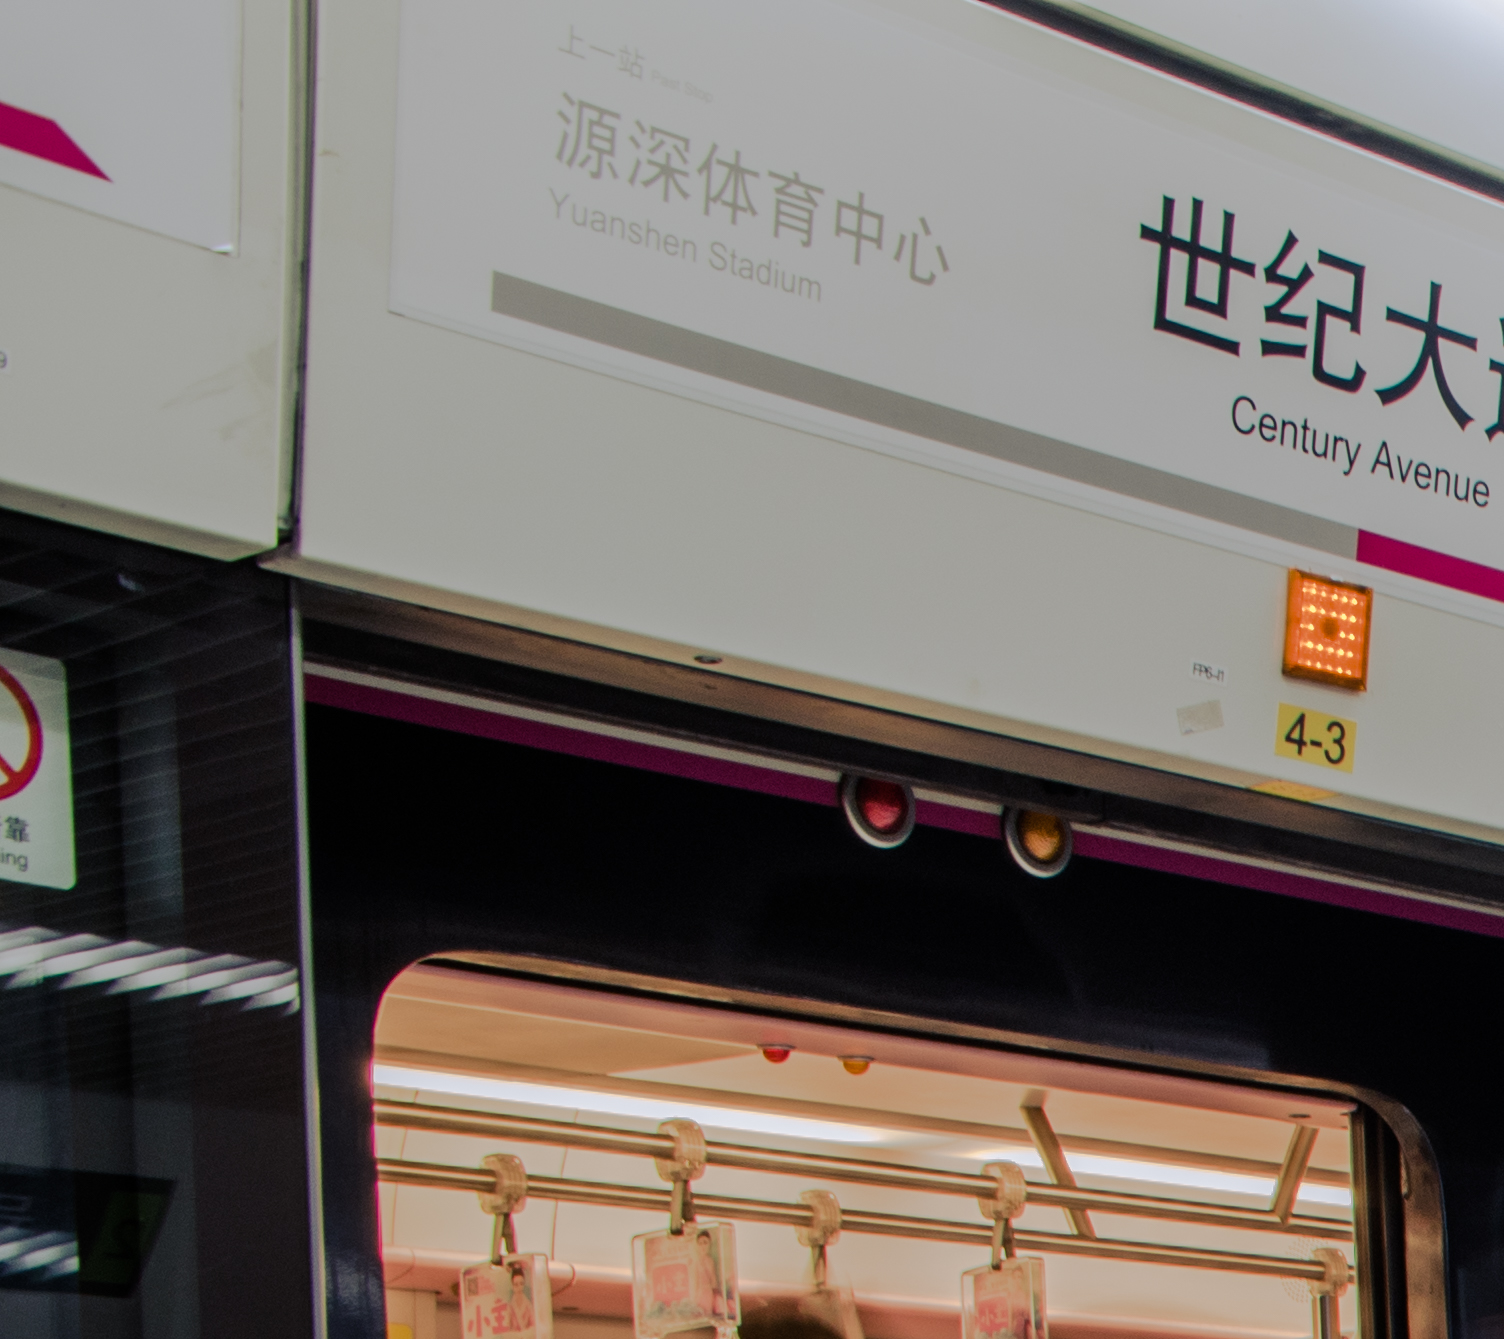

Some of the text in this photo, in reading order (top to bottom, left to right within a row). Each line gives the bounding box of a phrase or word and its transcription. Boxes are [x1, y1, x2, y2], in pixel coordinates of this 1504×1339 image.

[557, 24, 645, 80] 上一站
[548, 187, 823, 302] Yuanshen Stadium
[555, 91, 950, 287] 源深体育中心
[1231, 396, 1491, 508] Century Avenue
[1284, 712, 1347, 765] 4-3
